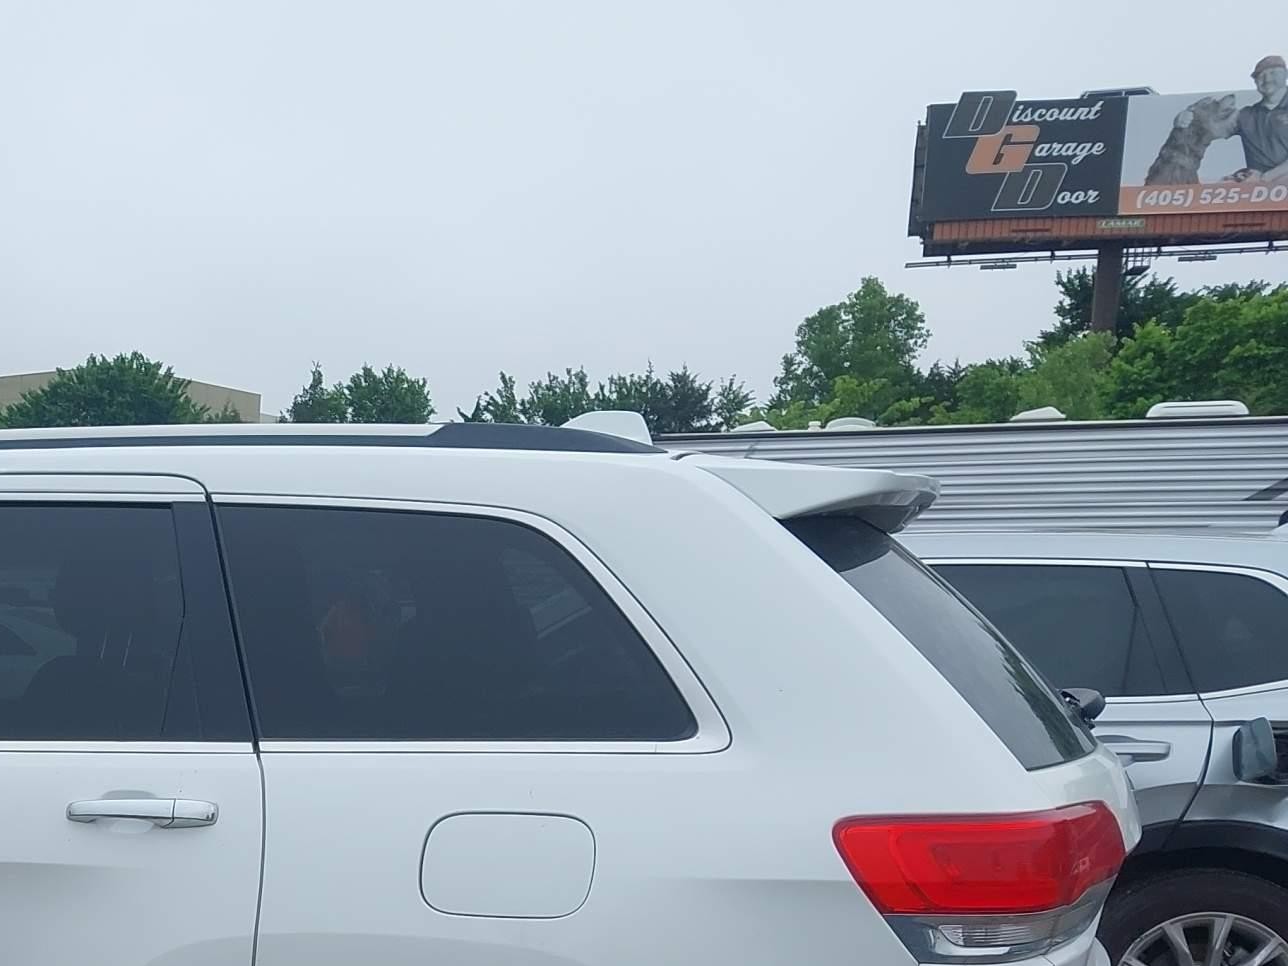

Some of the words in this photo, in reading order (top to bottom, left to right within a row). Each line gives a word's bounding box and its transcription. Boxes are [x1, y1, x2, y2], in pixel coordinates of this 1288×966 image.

[942, 90, 1104, 138] Discount
[966, 125, 1105, 174] Garage
[991, 163, 1099, 211] Door
[1136, 189, 1194, 208] (405)
[1199, 185, 1288, 204] 525-DO
